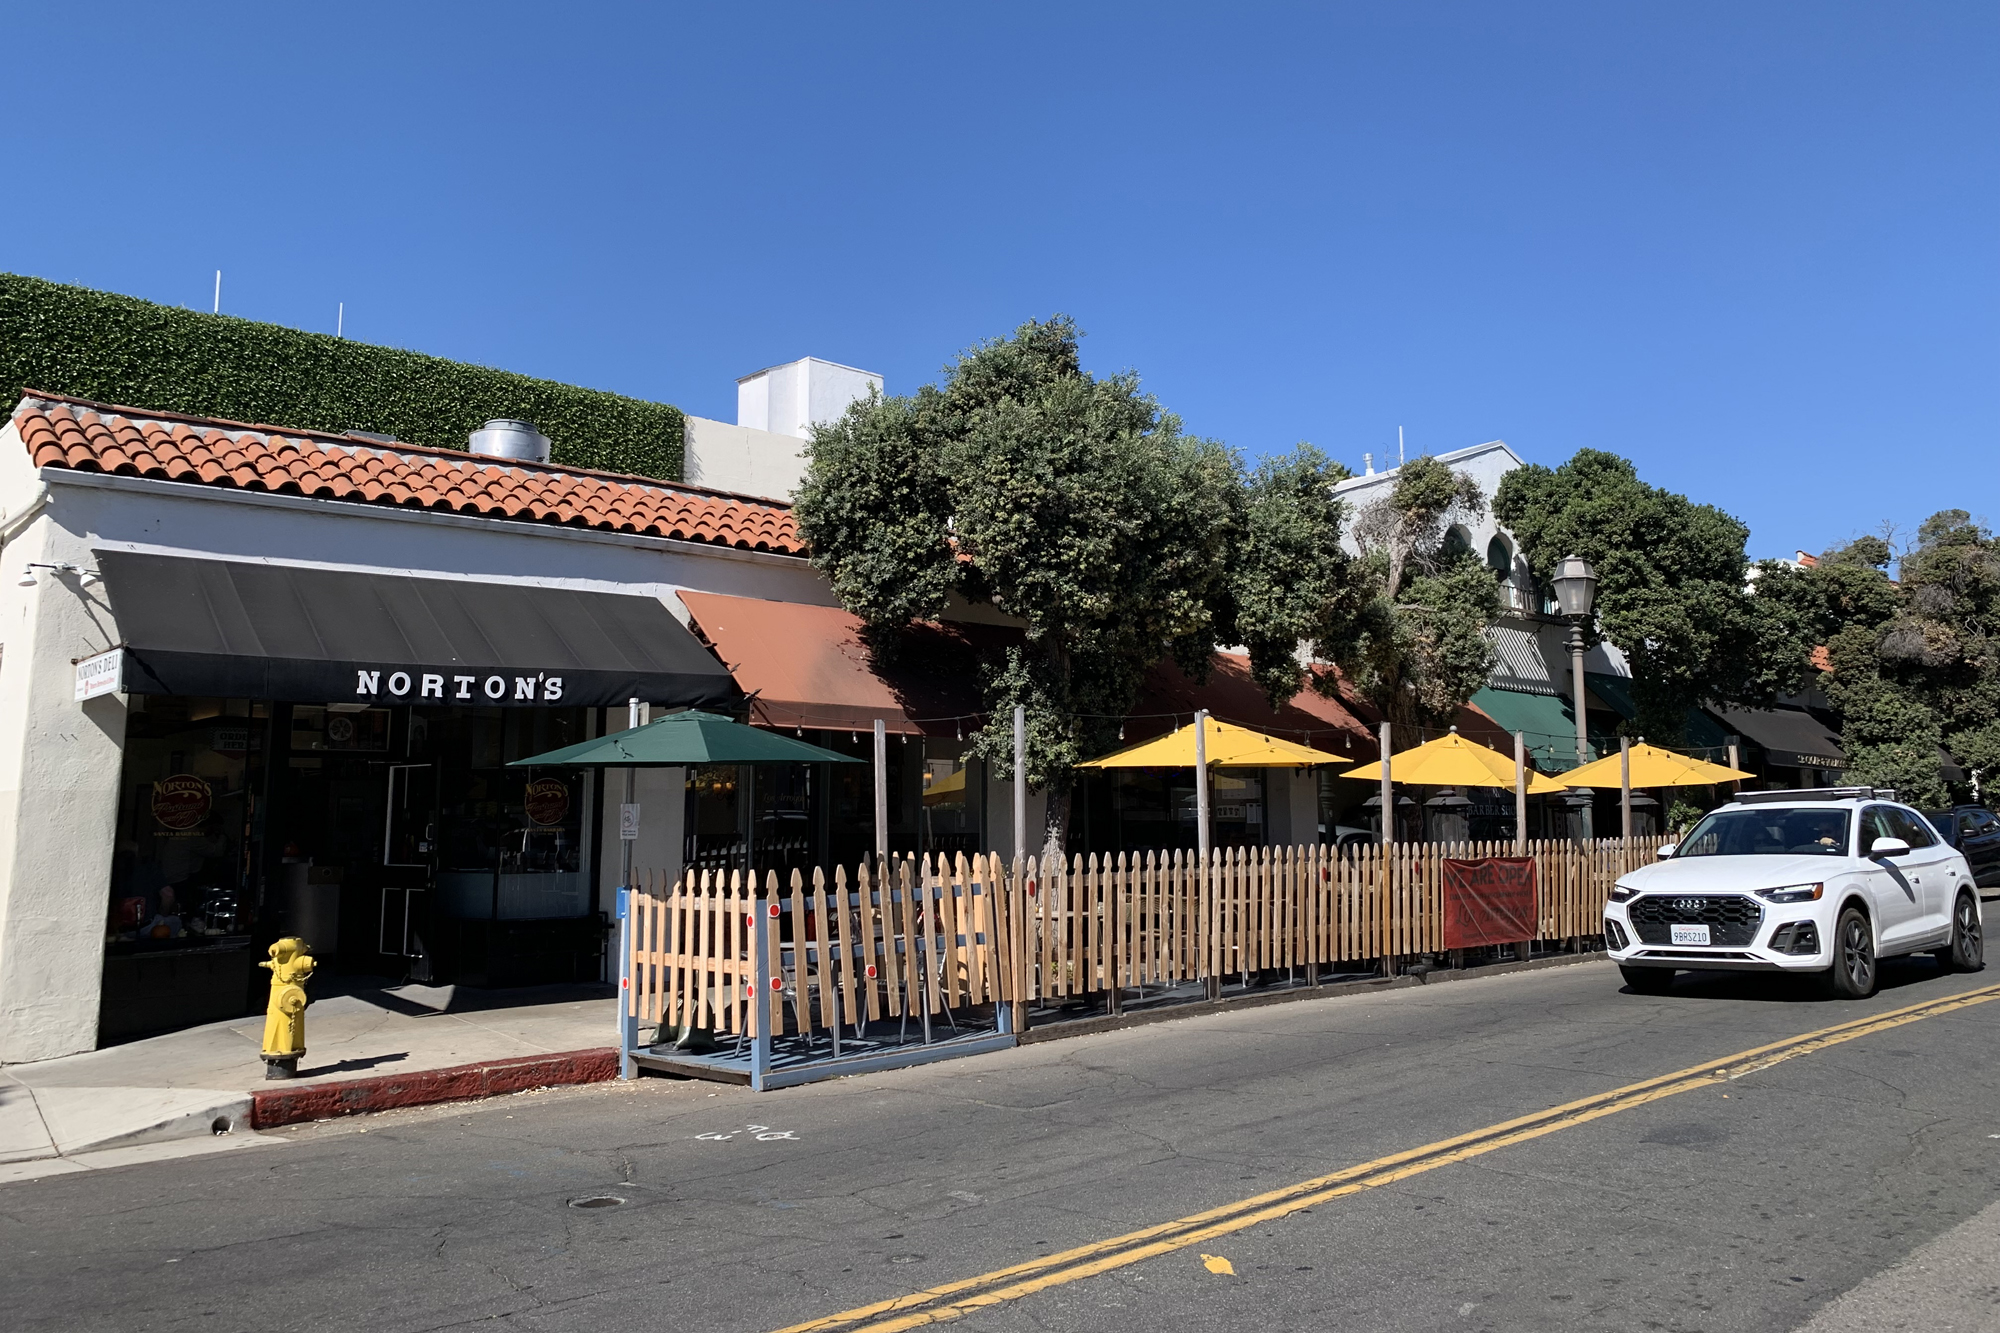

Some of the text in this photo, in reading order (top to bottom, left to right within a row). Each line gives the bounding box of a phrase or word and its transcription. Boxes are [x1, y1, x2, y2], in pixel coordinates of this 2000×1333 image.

[103, 654, 118, 673] DELI
[356, 670, 563, 700] NORTON'S
[1468, 804, 1500, 816] BARBER
[1445, 864, 1532, 890] WE ARE OPEN
